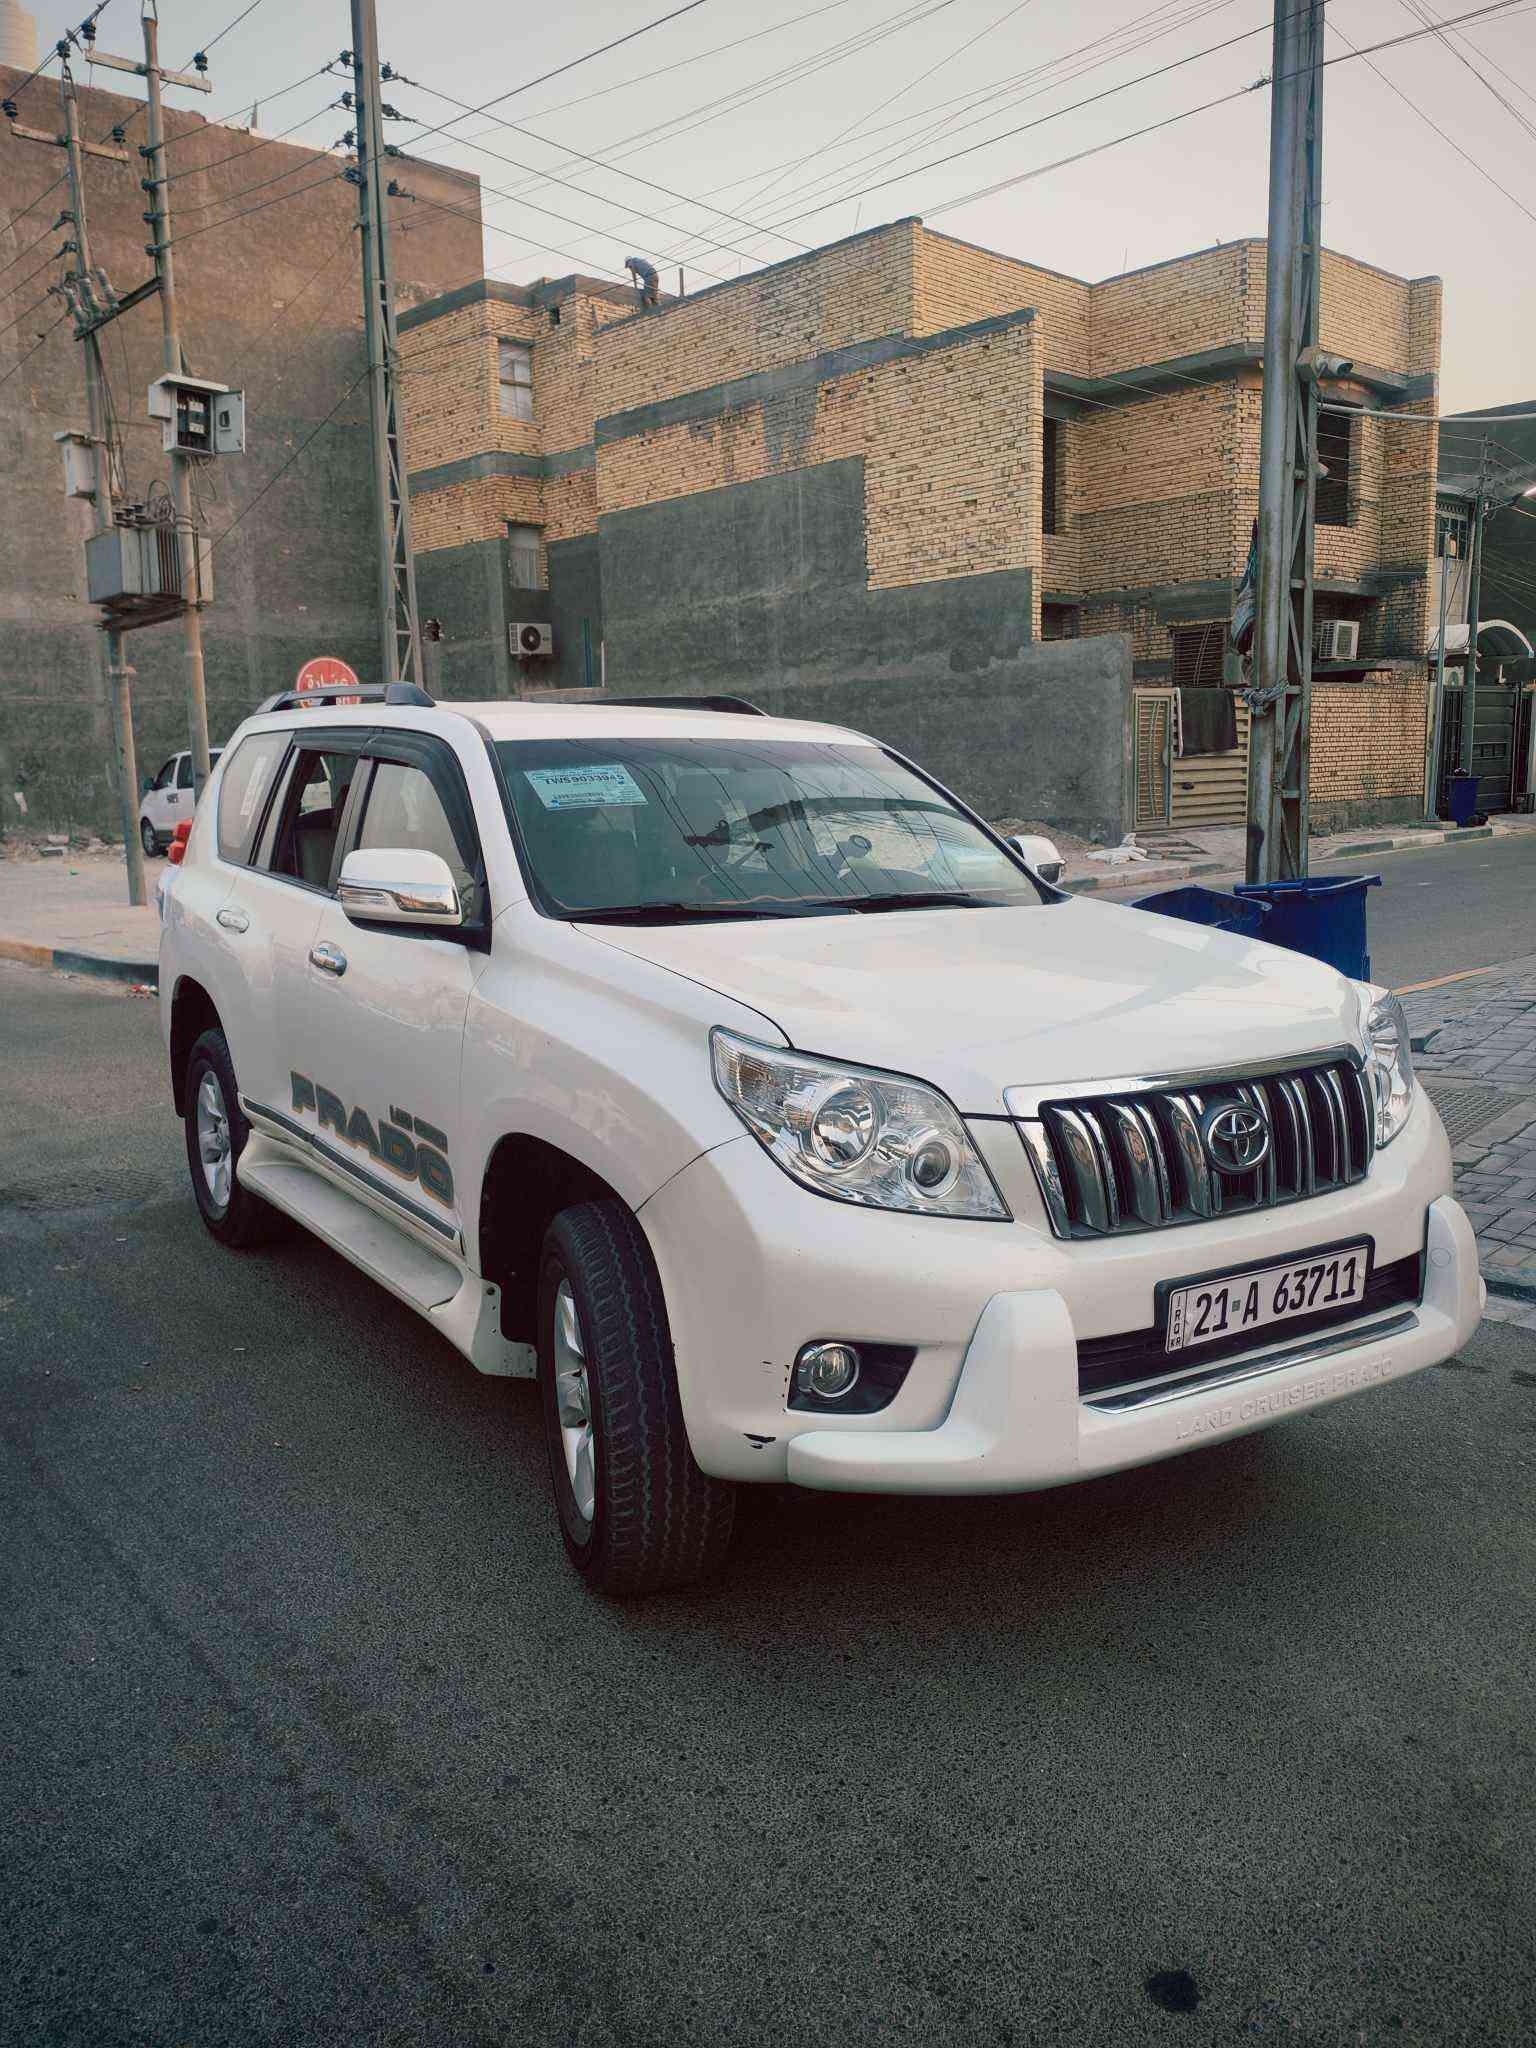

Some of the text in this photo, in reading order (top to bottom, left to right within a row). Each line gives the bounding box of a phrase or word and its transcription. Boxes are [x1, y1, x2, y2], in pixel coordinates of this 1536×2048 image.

[290, 1069, 455, 1210] PRADO
[1193, 1256, 1357, 1338] 21 A 63711
[1175, 1357, 1393, 1440] LAND CRUISER PRADO
